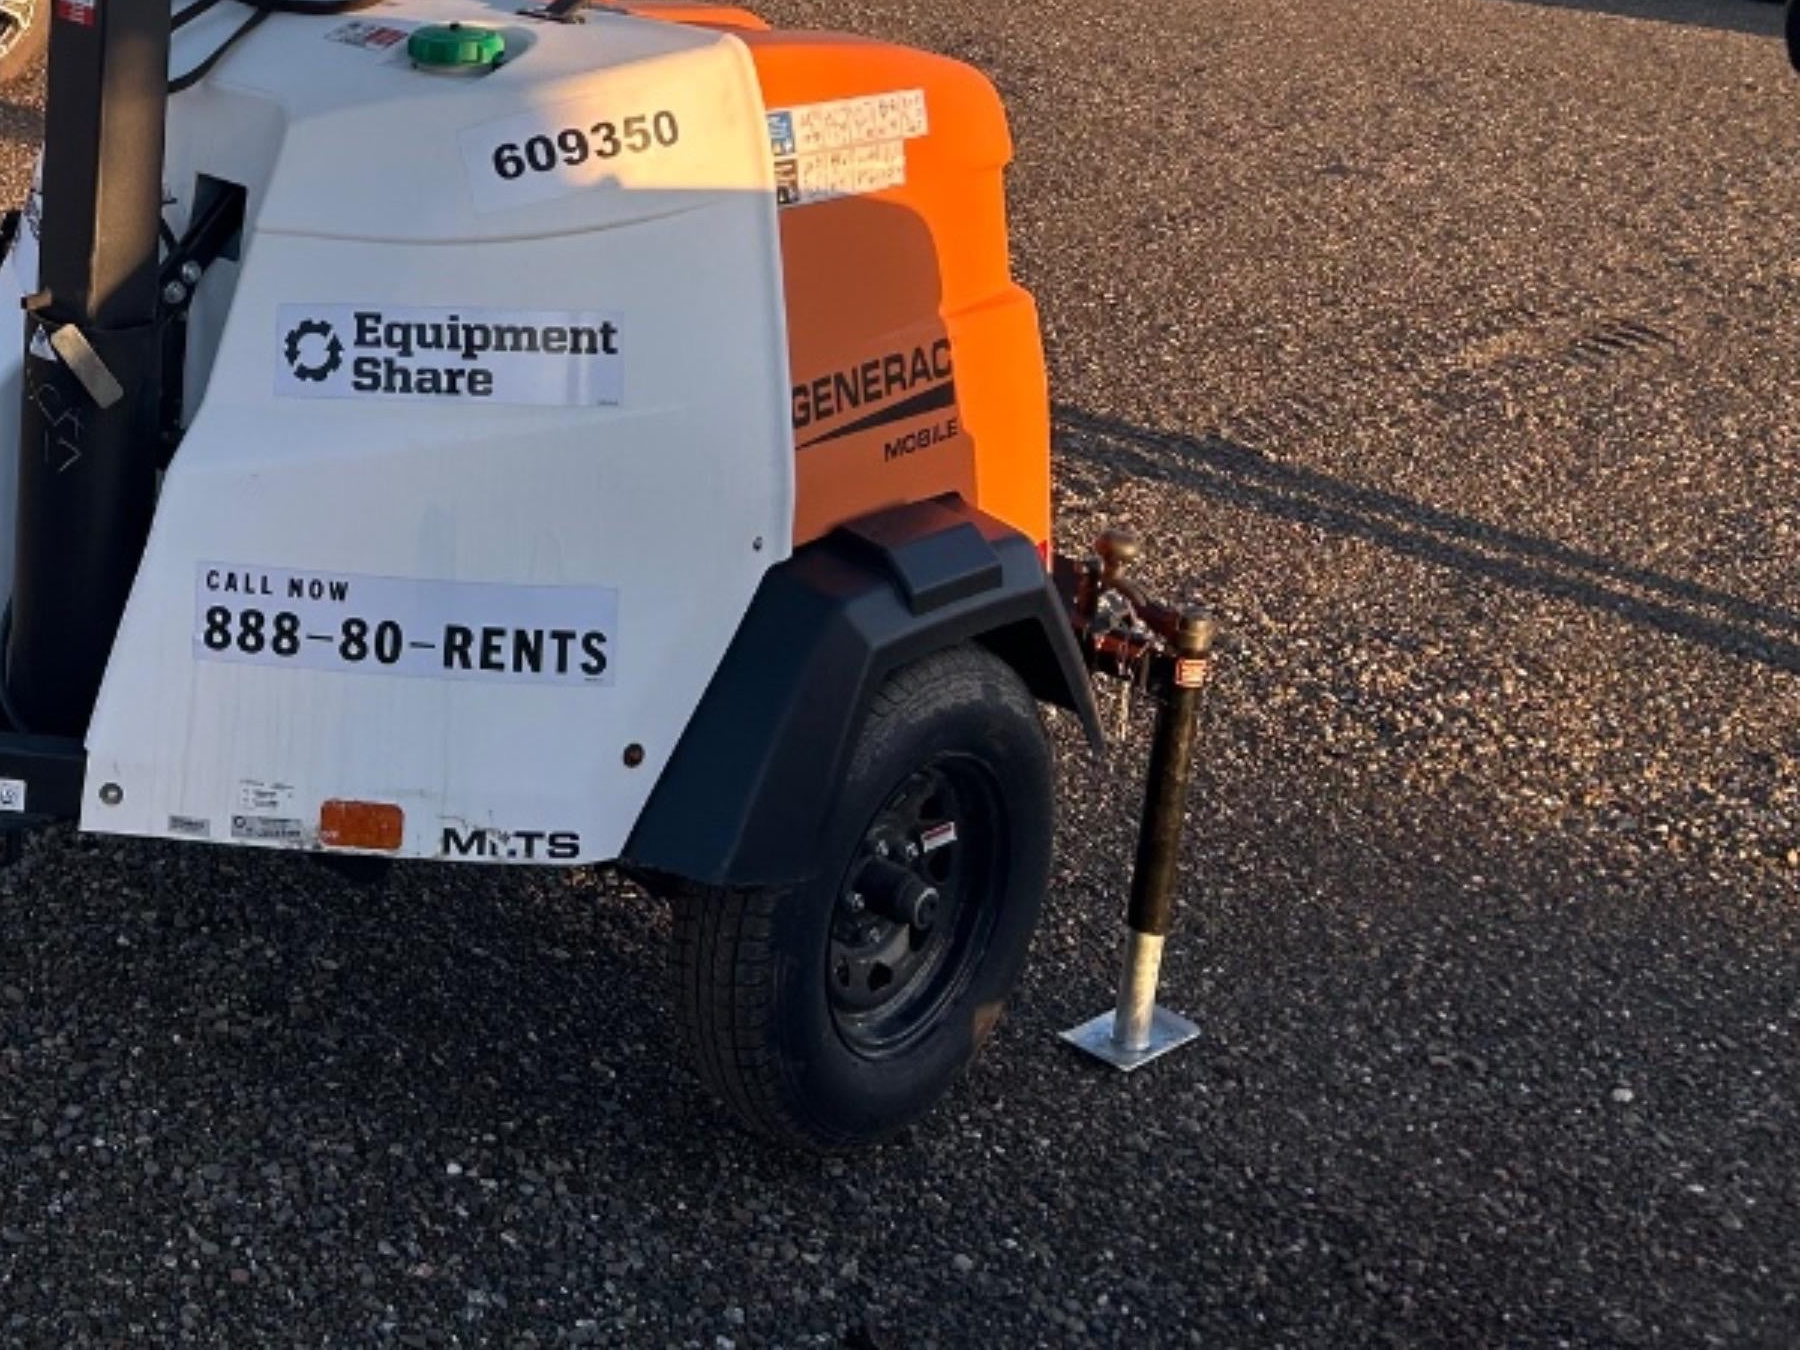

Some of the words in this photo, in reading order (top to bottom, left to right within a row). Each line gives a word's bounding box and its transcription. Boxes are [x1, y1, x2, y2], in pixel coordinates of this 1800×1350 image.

[493, 110, 679, 180] 609350
[354, 311, 618, 360] Equipment
[352, 356, 493, 396] Share
[792, 338, 952, 429] GENERAC
[884, 417, 958, 462] MOBILE
[206, 570, 273, 596] CALL
[287, 578, 349, 601] NOW
[203, 605, 609, 676] 888-80-RENTS
